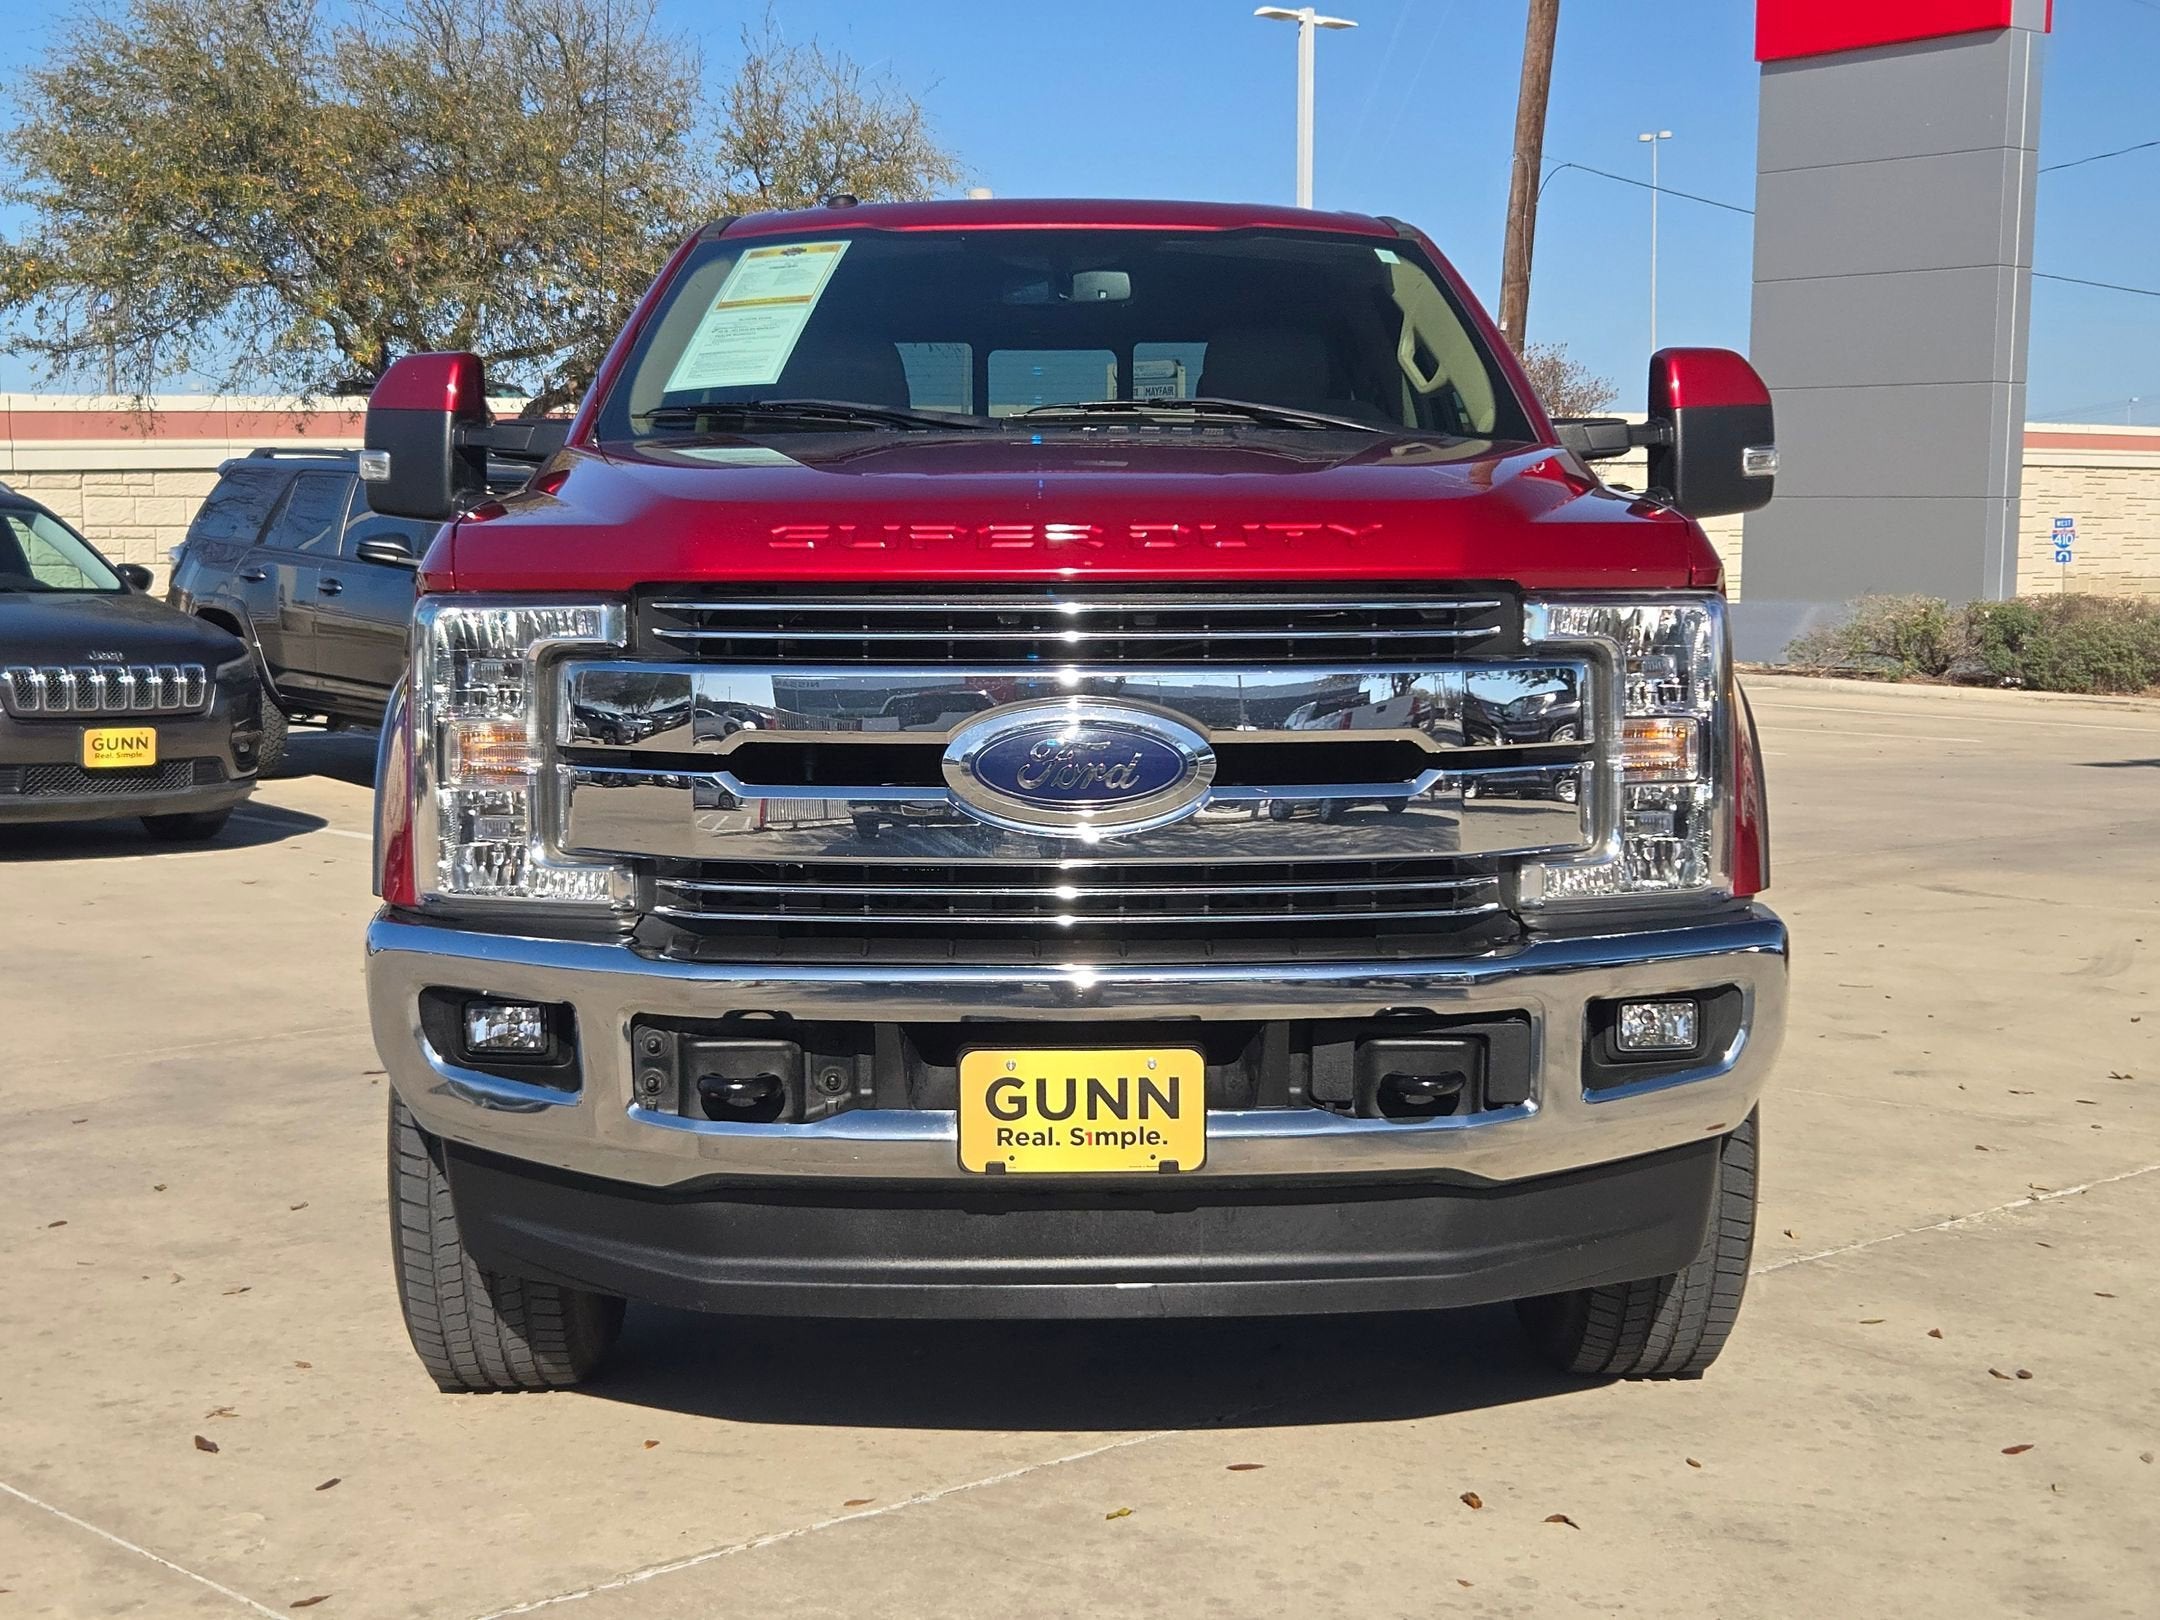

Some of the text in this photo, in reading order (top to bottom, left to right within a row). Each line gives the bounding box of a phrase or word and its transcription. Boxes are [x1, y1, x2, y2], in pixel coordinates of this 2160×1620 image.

[1145, 386, 1174, 397] MAYFAIR
[768, 524, 1383, 549] SUPER DUTY
[2054, 534, 2073, 545] 410
[92, 736, 149, 752] GUNN
[1017, 738, 1142, 790] Ford
[985, 1076, 1180, 1121] GUNN
[996, 1127, 1061, 1147] Real.
